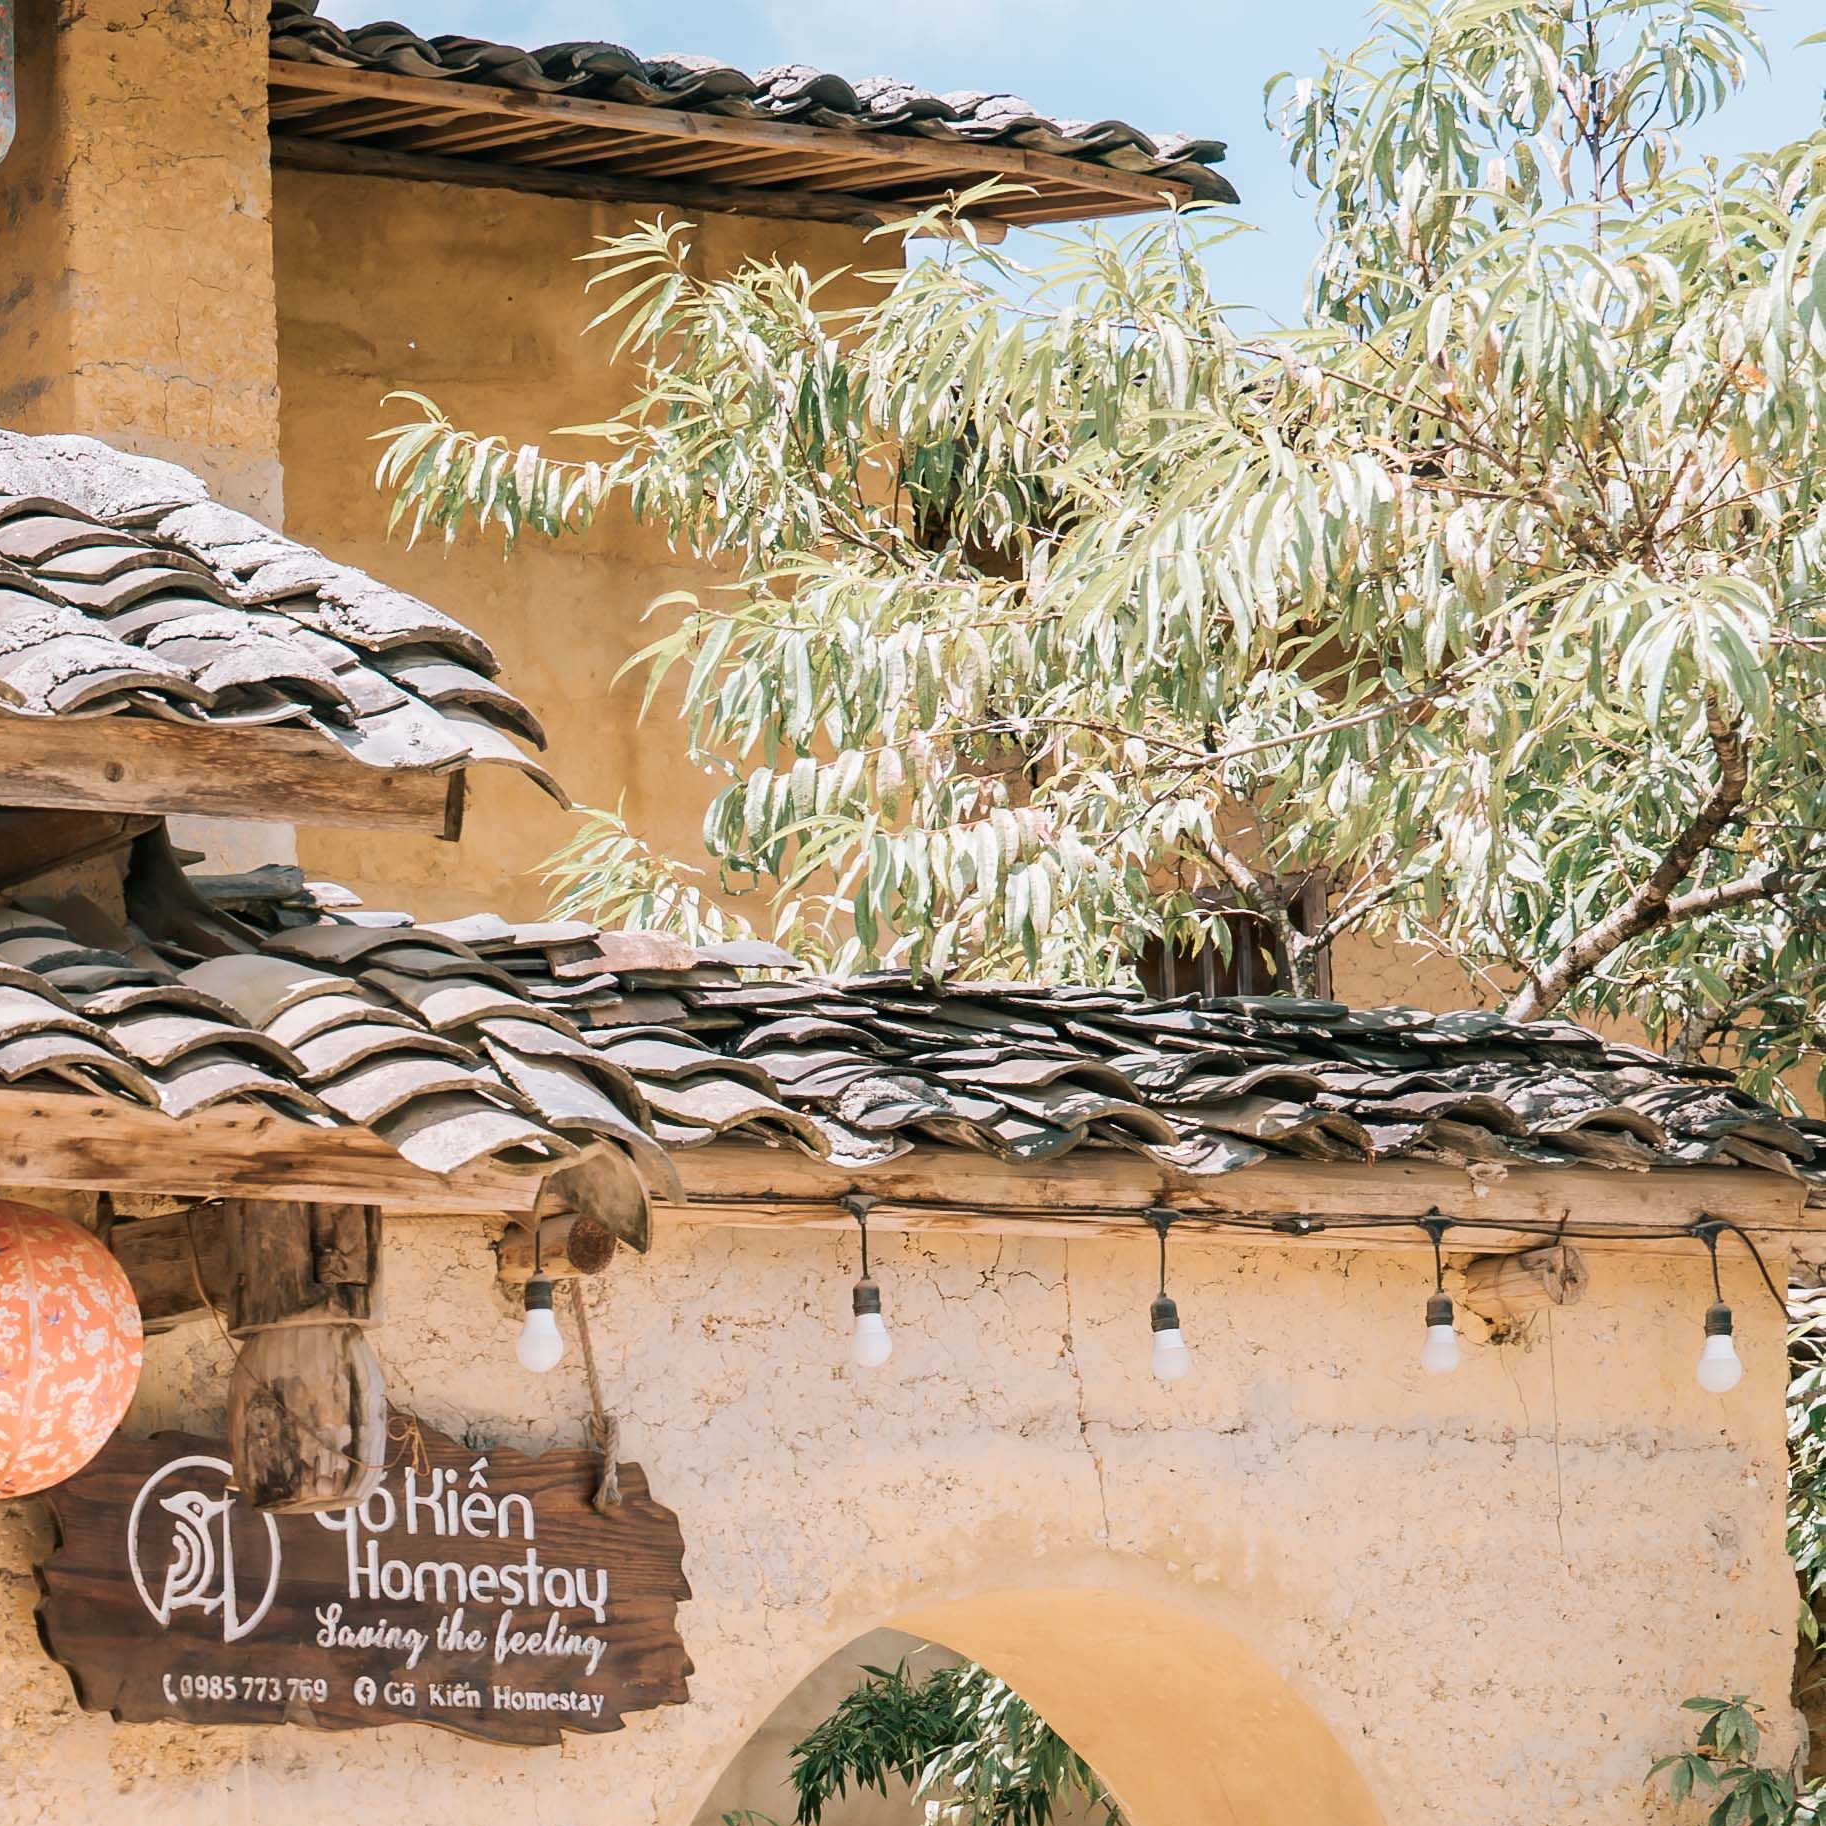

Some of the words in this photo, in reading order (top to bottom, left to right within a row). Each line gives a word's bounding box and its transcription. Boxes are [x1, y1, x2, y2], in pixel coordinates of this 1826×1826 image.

[404, 1456, 535, 1540] Kiến
[347, 1539, 608, 1624] Homestay
[315, 1602, 429, 1670] Saving
[436, 1607, 487, 1651] the
[494, 1608, 608, 1676] feeling
[383, 1681, 416, 1706] Gõ
[428, 1681, 482, 1709] Kiến
[492, 1684, 605, 1718] Homestay
